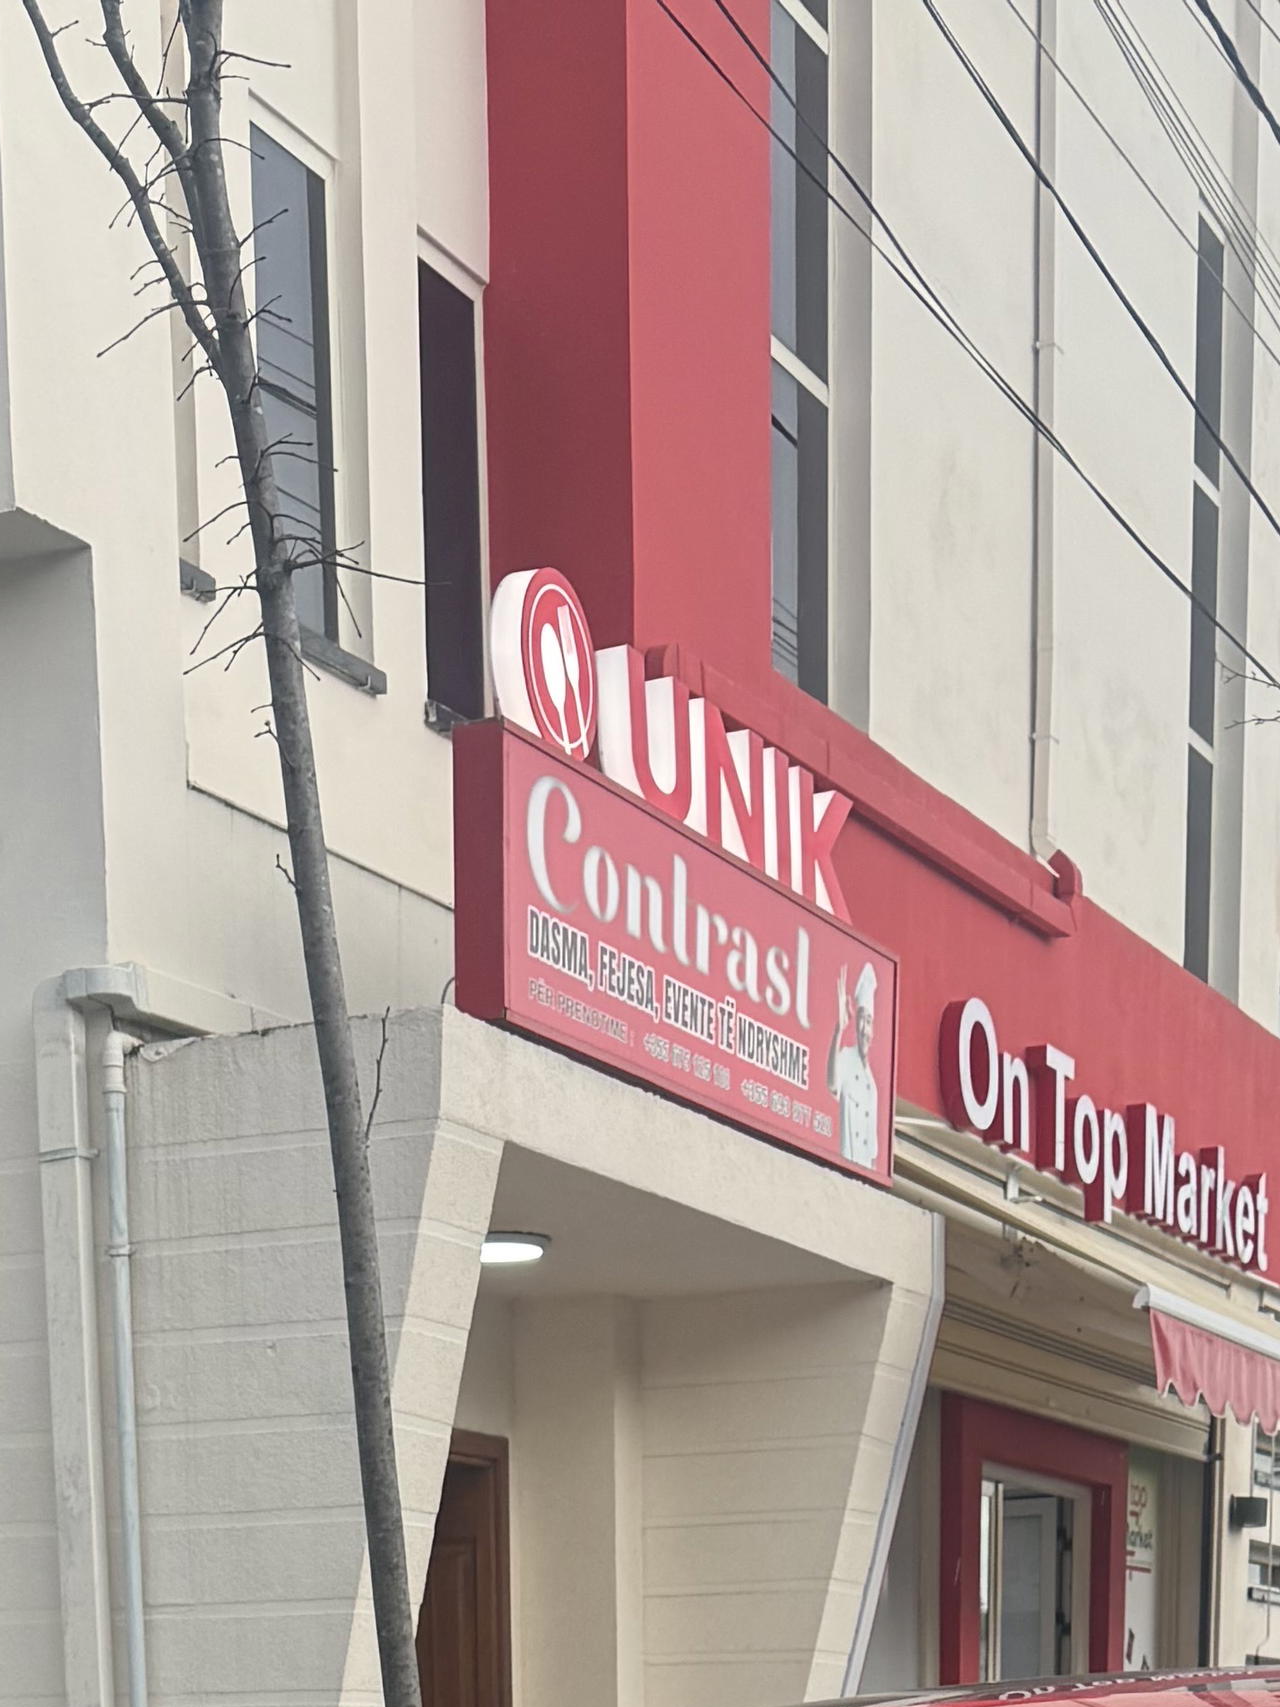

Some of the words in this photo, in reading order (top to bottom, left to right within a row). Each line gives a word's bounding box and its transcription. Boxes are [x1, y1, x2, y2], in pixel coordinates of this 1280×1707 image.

[527, 904, 594, 993] DASMA,
[598, 942, 660, 1024] FEJESA,
[663, 975, 716, 1045] EVENTE
[719, 995, 736, 1055] TË
[736, 1012, 810, 1091] NDRYSHME
[528, 976, 556, 1006] PËR
[956, 997, 1030, 1153] On
[1044, 1044, 1129, 1223] Top
[1142, 1102, 1269, 1271] Market
